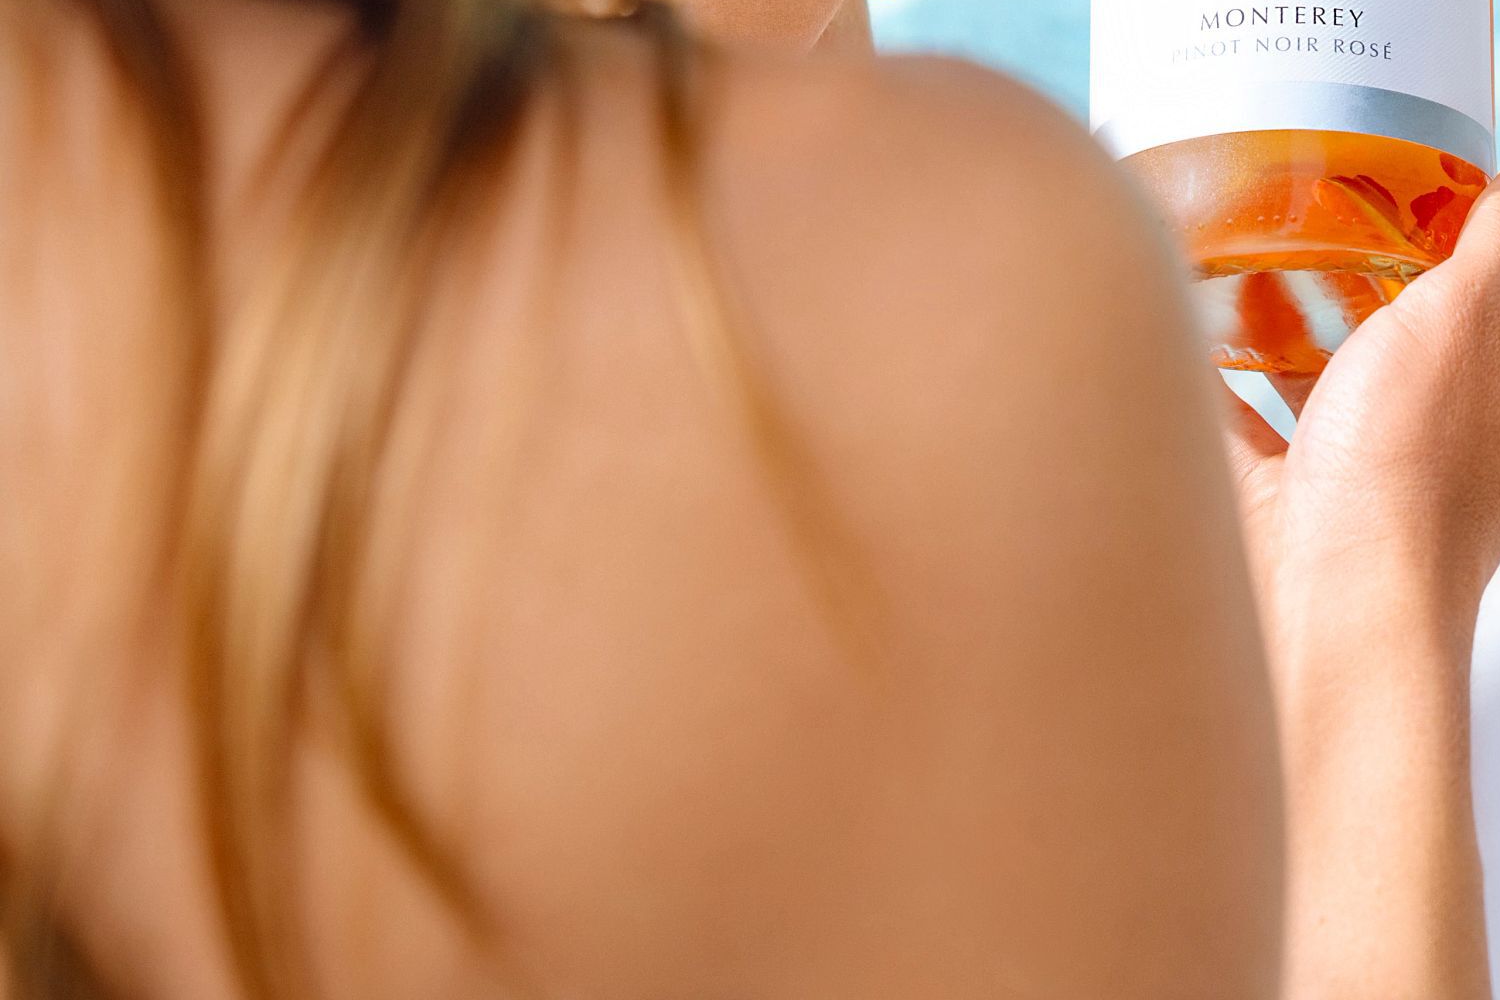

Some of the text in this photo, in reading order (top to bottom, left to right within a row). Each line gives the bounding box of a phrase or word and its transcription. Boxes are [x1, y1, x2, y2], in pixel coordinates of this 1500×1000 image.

[1201, 6, 1364, 31] MONTEREY
[1256, 36, 1319, 53] NOIR
[1334, 38, 1392, 60] ROSÉ
